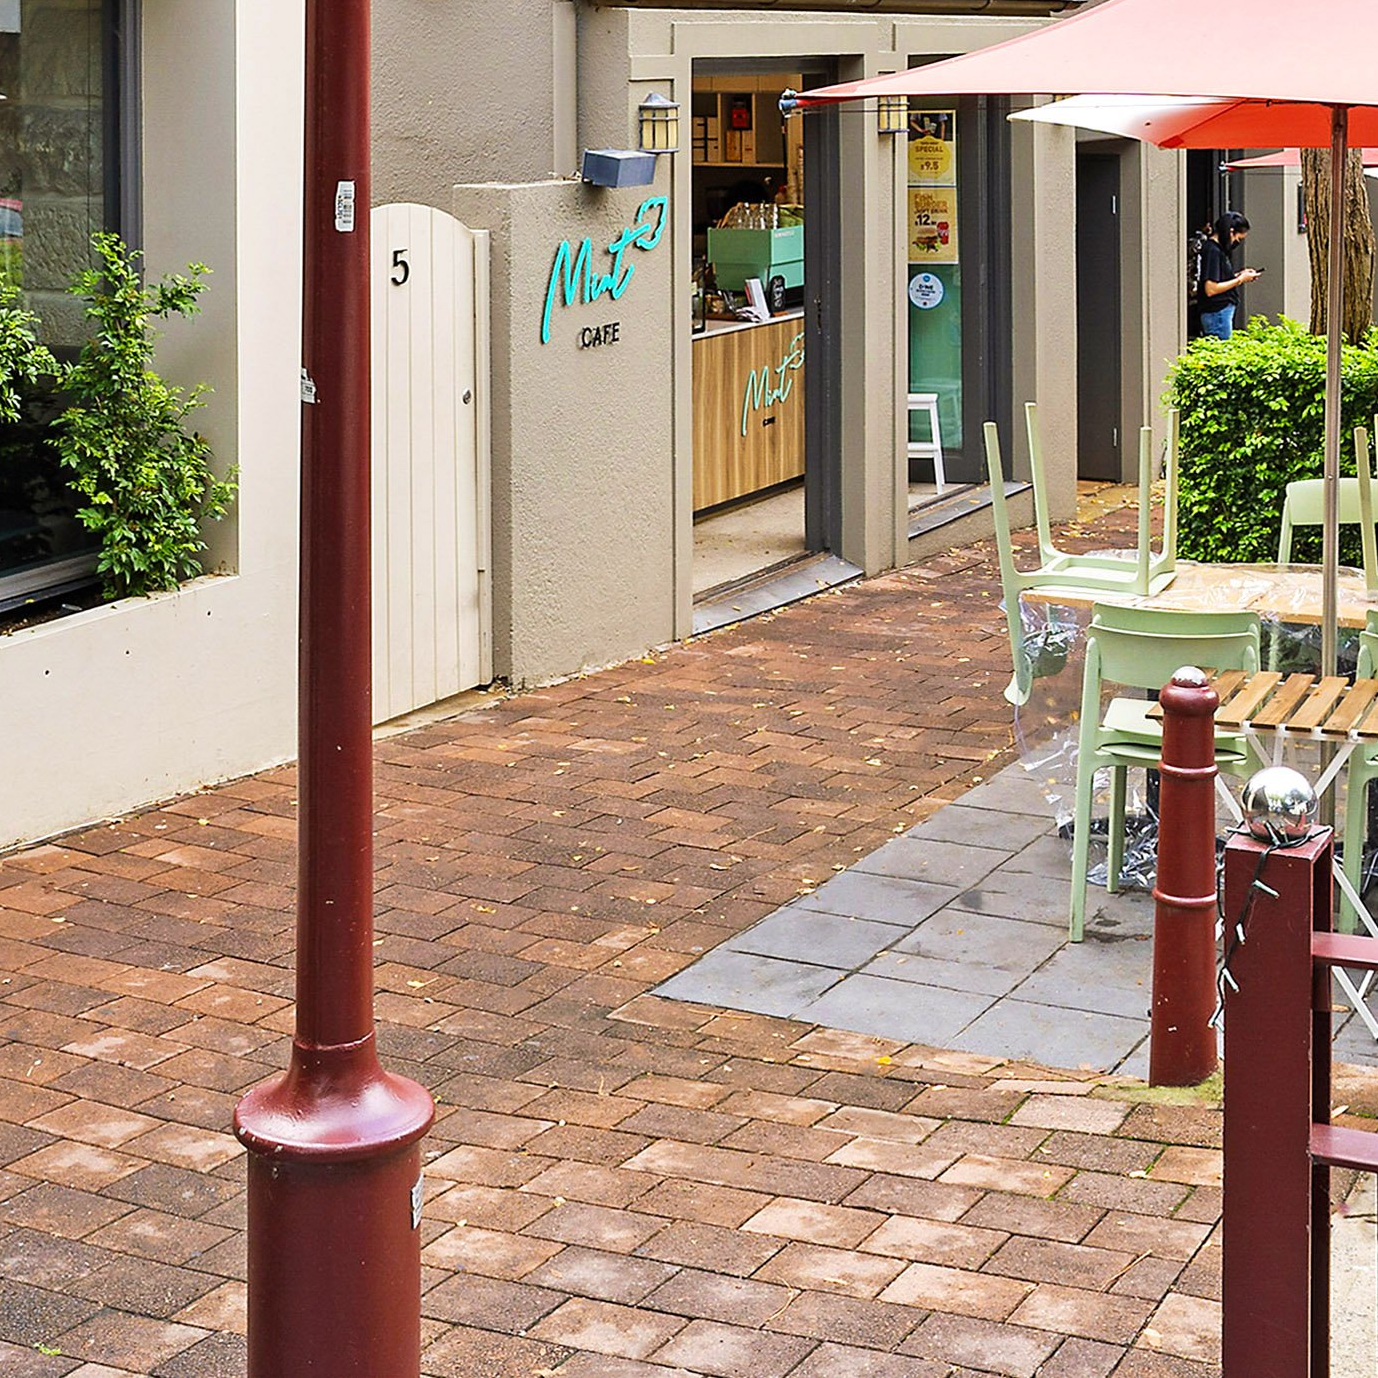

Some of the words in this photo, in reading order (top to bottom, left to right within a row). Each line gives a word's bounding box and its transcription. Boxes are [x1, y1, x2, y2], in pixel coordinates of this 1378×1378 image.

[915, 146, 944, 154] SPECIAL
[390, 248, 410, 287] 5
[542, 223, 651, 344] Mint
[579, 322, 621, 349] CAFE
